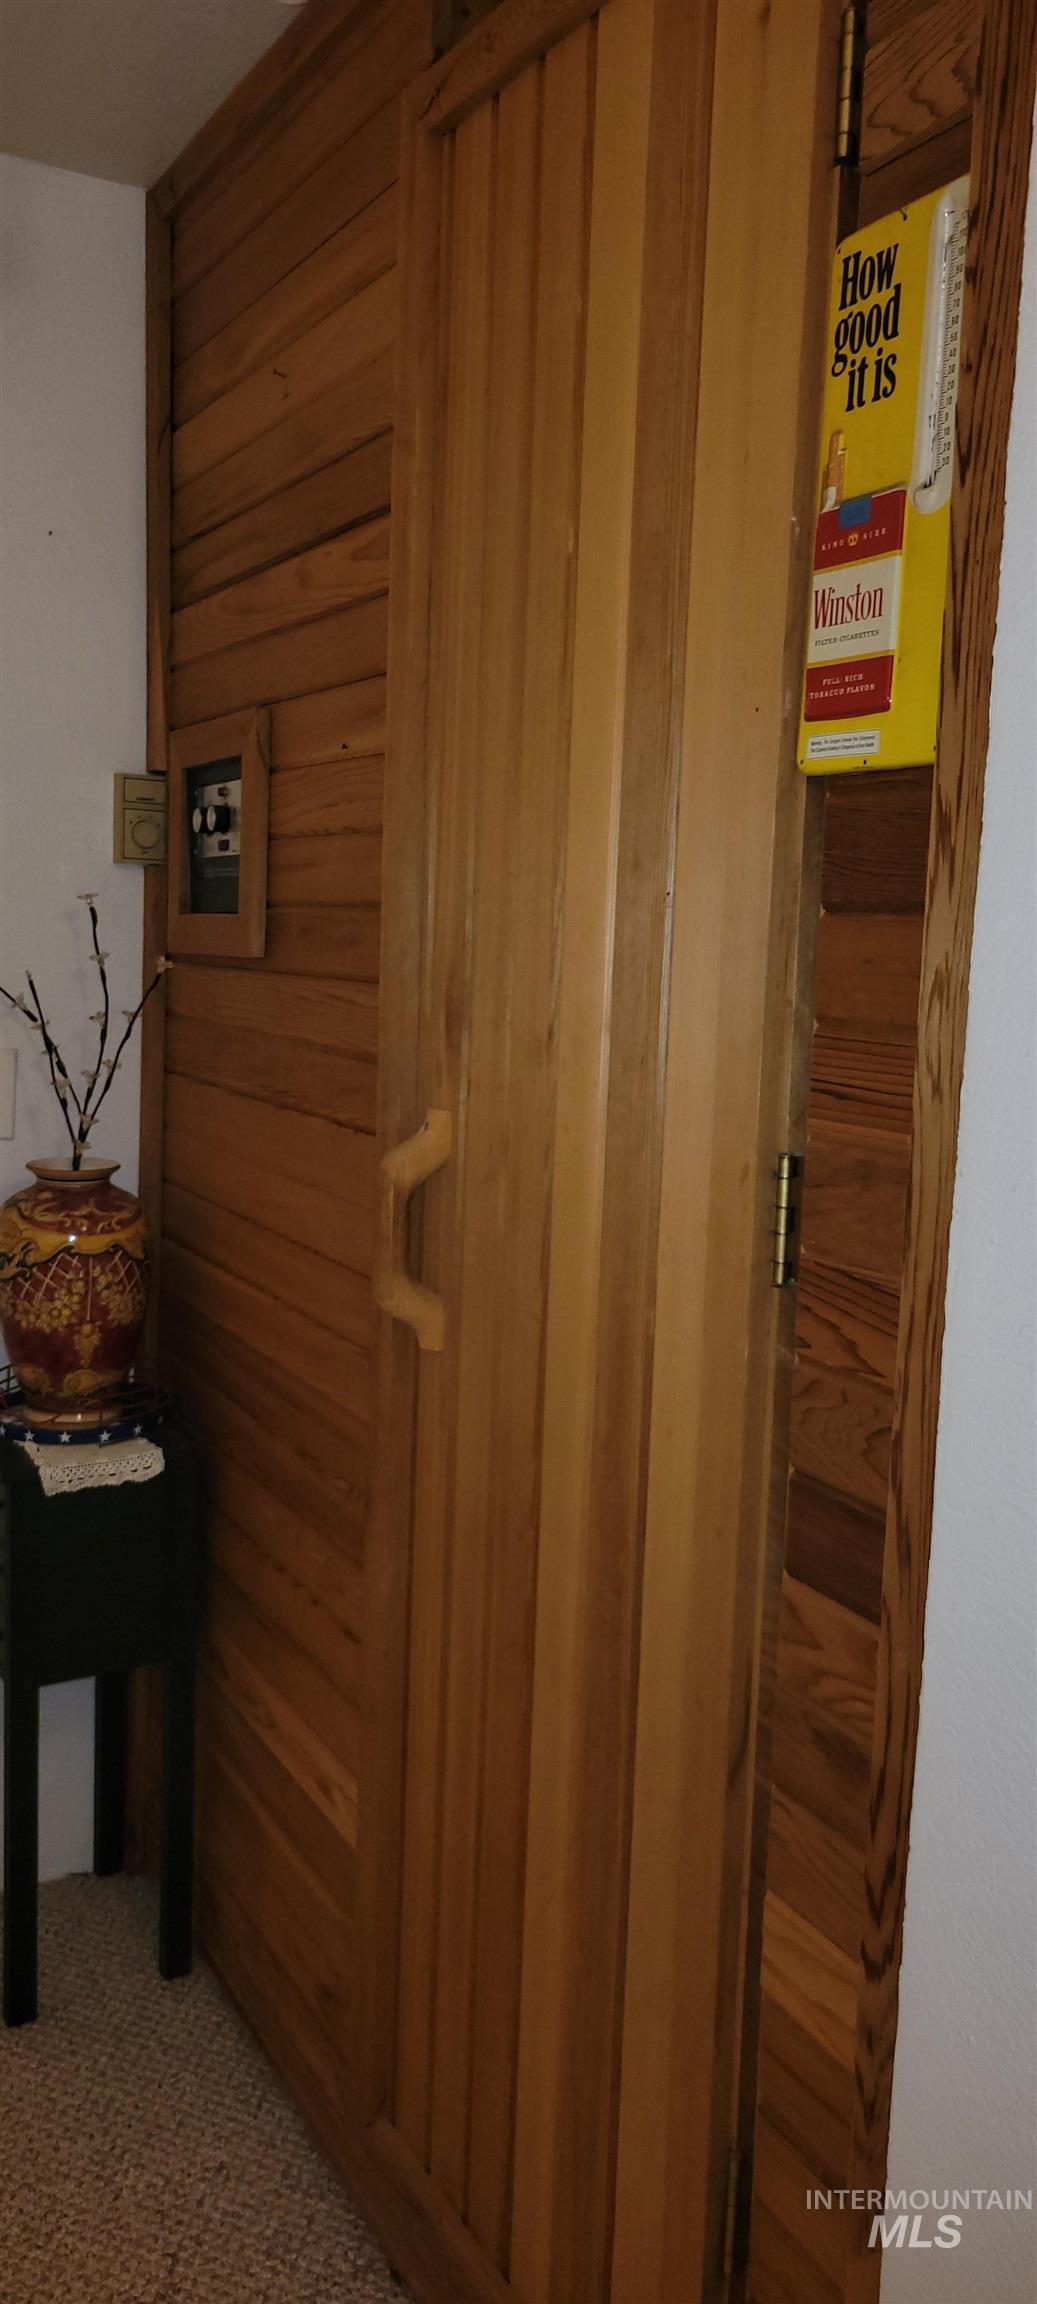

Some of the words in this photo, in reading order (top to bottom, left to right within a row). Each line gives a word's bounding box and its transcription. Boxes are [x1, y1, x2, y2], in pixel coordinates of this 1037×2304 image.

[838, 243, 899, 311] How
[831, 282, 901, 377] good
[845, 356, 868, 412] it
[871, 347, 897, 403] is
[813, 583, 884, 630] Winston
[809, 687, 845, 700] TOBACCO
[846, 683, 875, 694] FLAVOR
